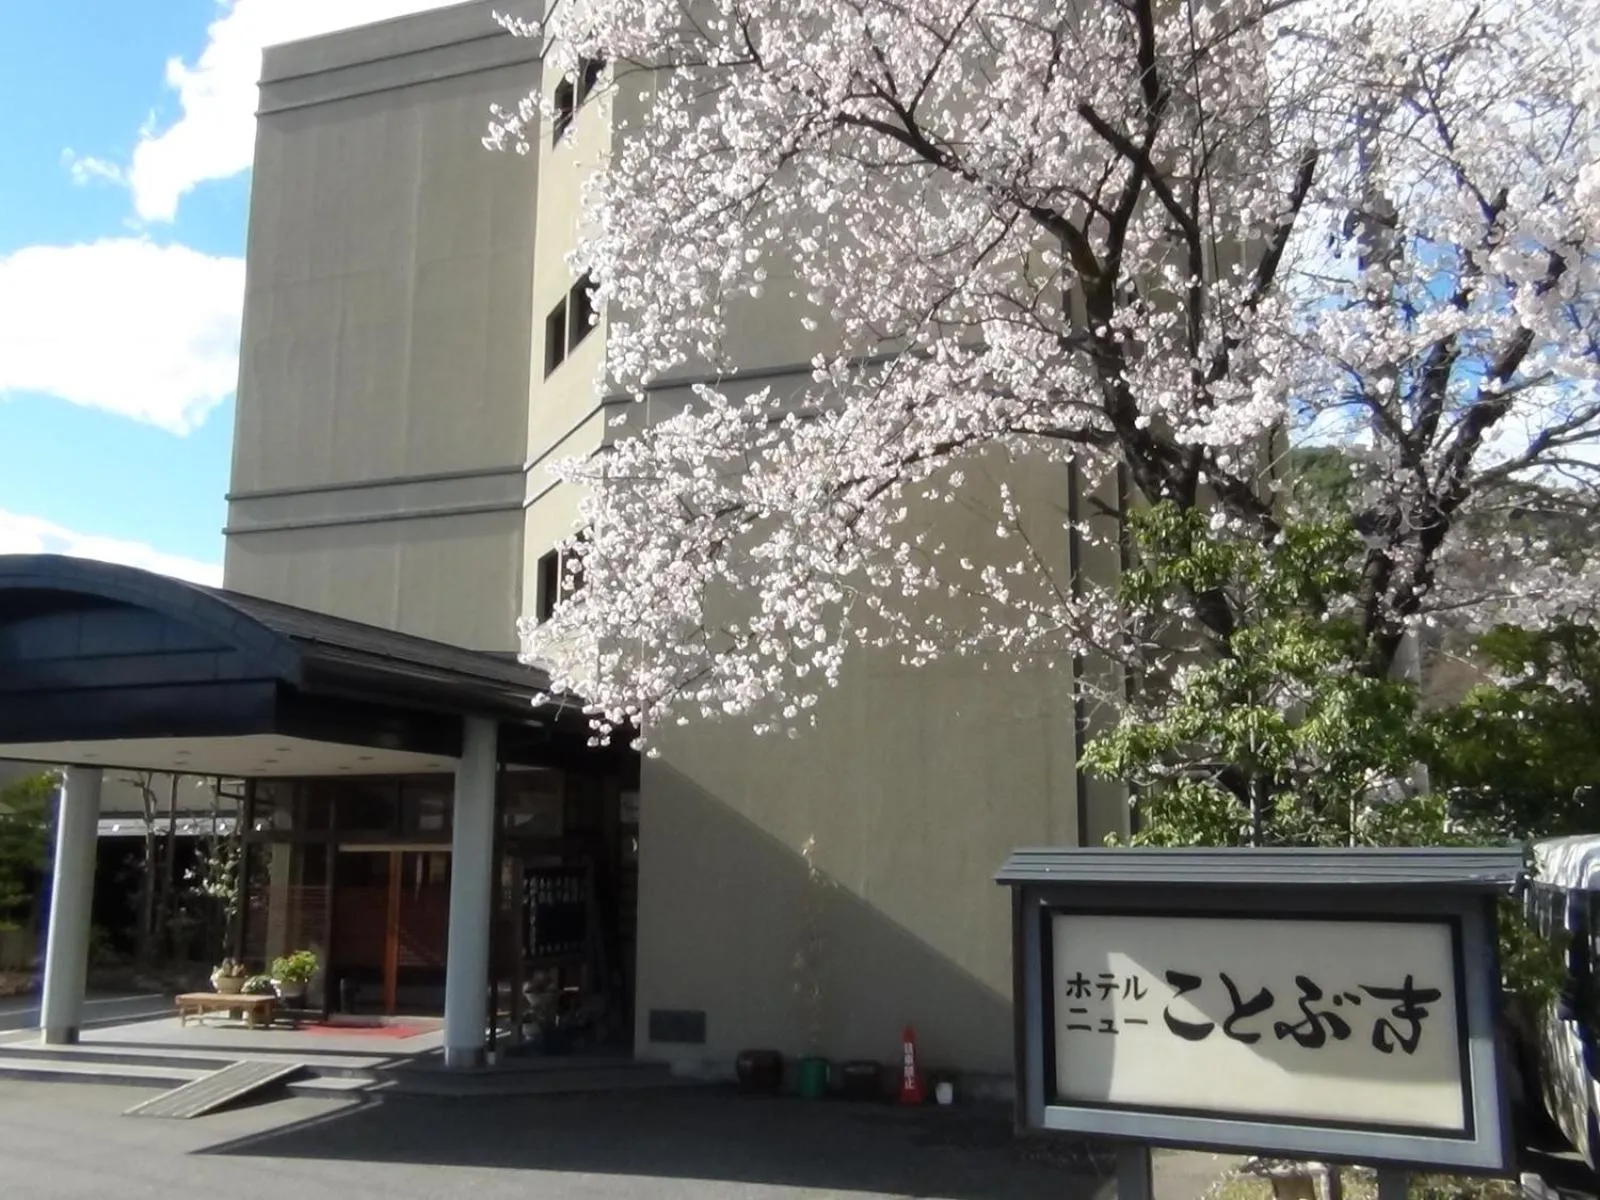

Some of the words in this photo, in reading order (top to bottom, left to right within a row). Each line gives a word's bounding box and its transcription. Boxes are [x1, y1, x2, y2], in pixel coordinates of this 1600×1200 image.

[1065, 971, 1149, 1001] ホテル
[1065, 1006, 1149, 1034] ニュー
[1162, 969, 1443, 1055] ことぶき
